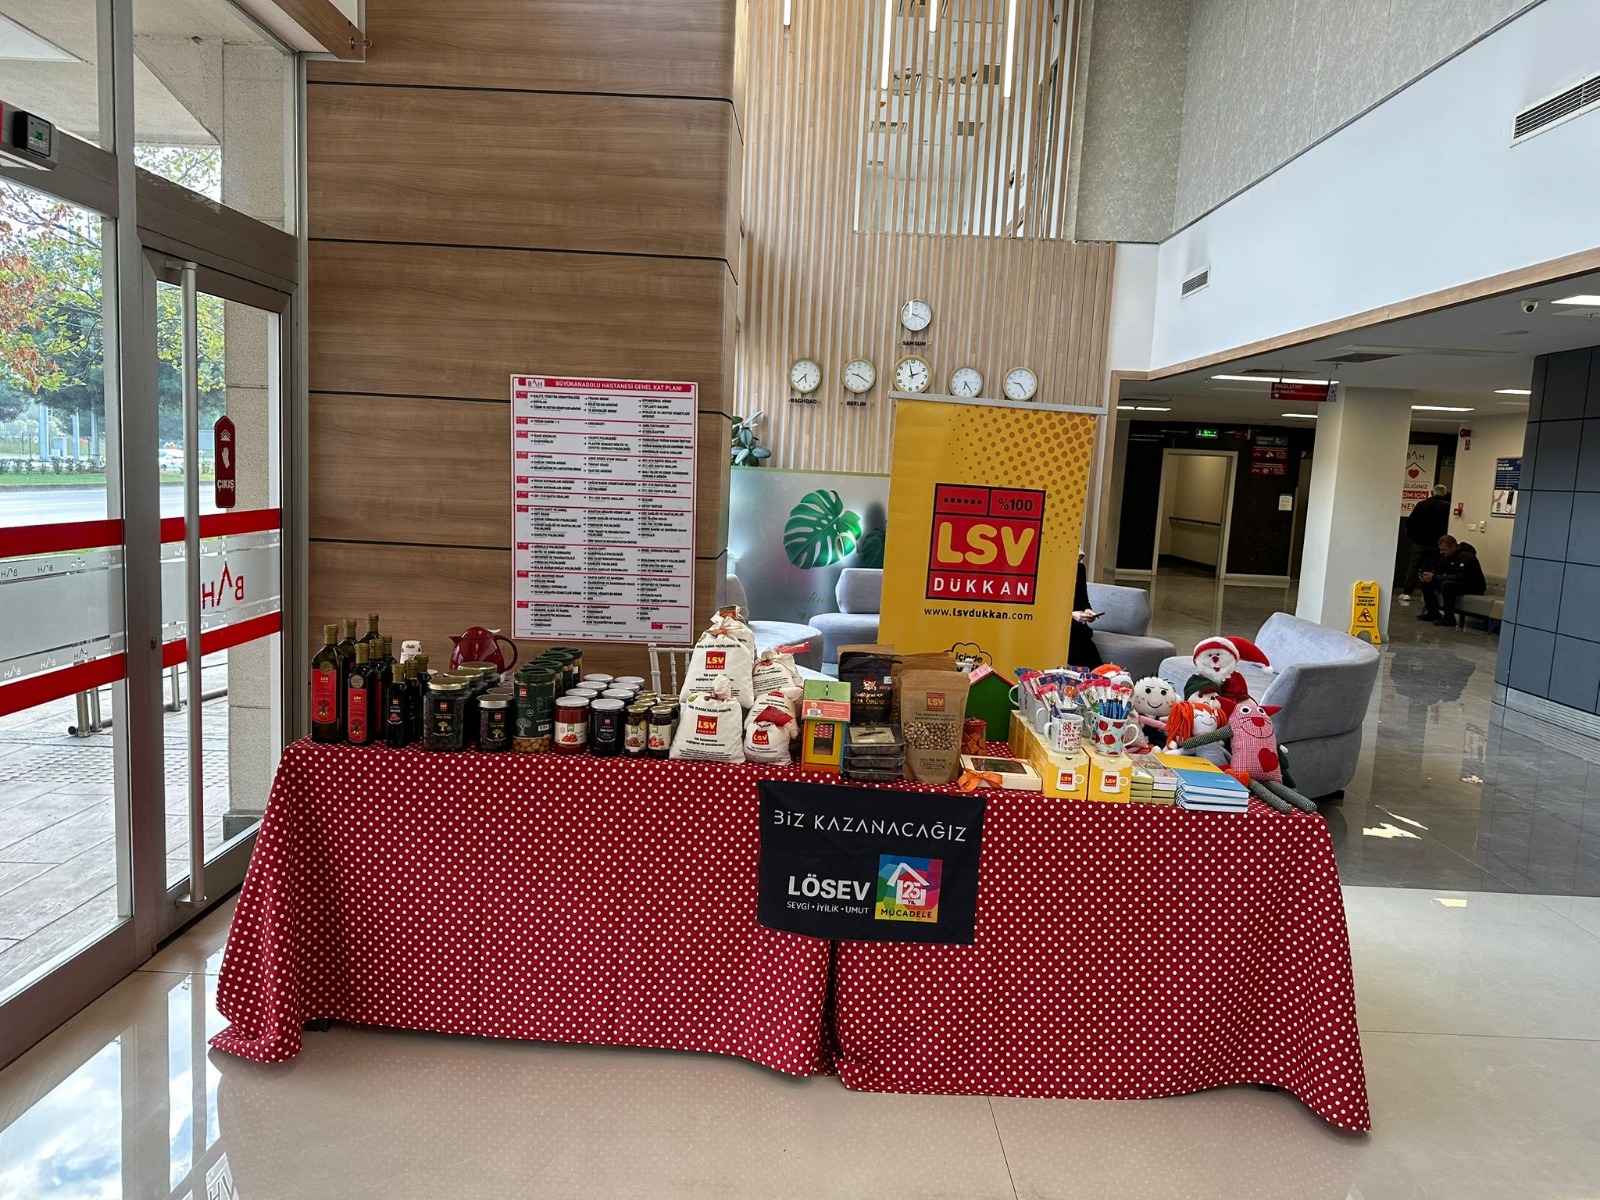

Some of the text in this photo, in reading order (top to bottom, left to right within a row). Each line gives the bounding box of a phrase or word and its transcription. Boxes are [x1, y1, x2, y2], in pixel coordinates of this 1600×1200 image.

[555, 380, 601, 388] BÜYÜKANADOLU
[602, 382, 634, 390] HASTANESİ
[217, 479, 235, 492] ÇIKIŞ
[998, 498, 1033, 512] %100
[937, 521, 1035, 567] LSV
[933, 577, 1029, 596] DÜKKAN
[924, 608, 1034, 621] www.lsvdukkan.com
[707, 656, 725, 664] LSV
[927, 698, 944, 706] LSV
[697, 720, 716, 730] LSV
[753, 733, 768, 741] LSV
[773, 810, 967, 842] BİZ KAZANACAĞIZ
[788, 873, 871, 901] LÖSEV
[902, 880, 922, 900] 25
[787, 901, 870, 915] SEVGİ İYİLİK UMUT
[880, 907, 932, 919] MÜCADELE
